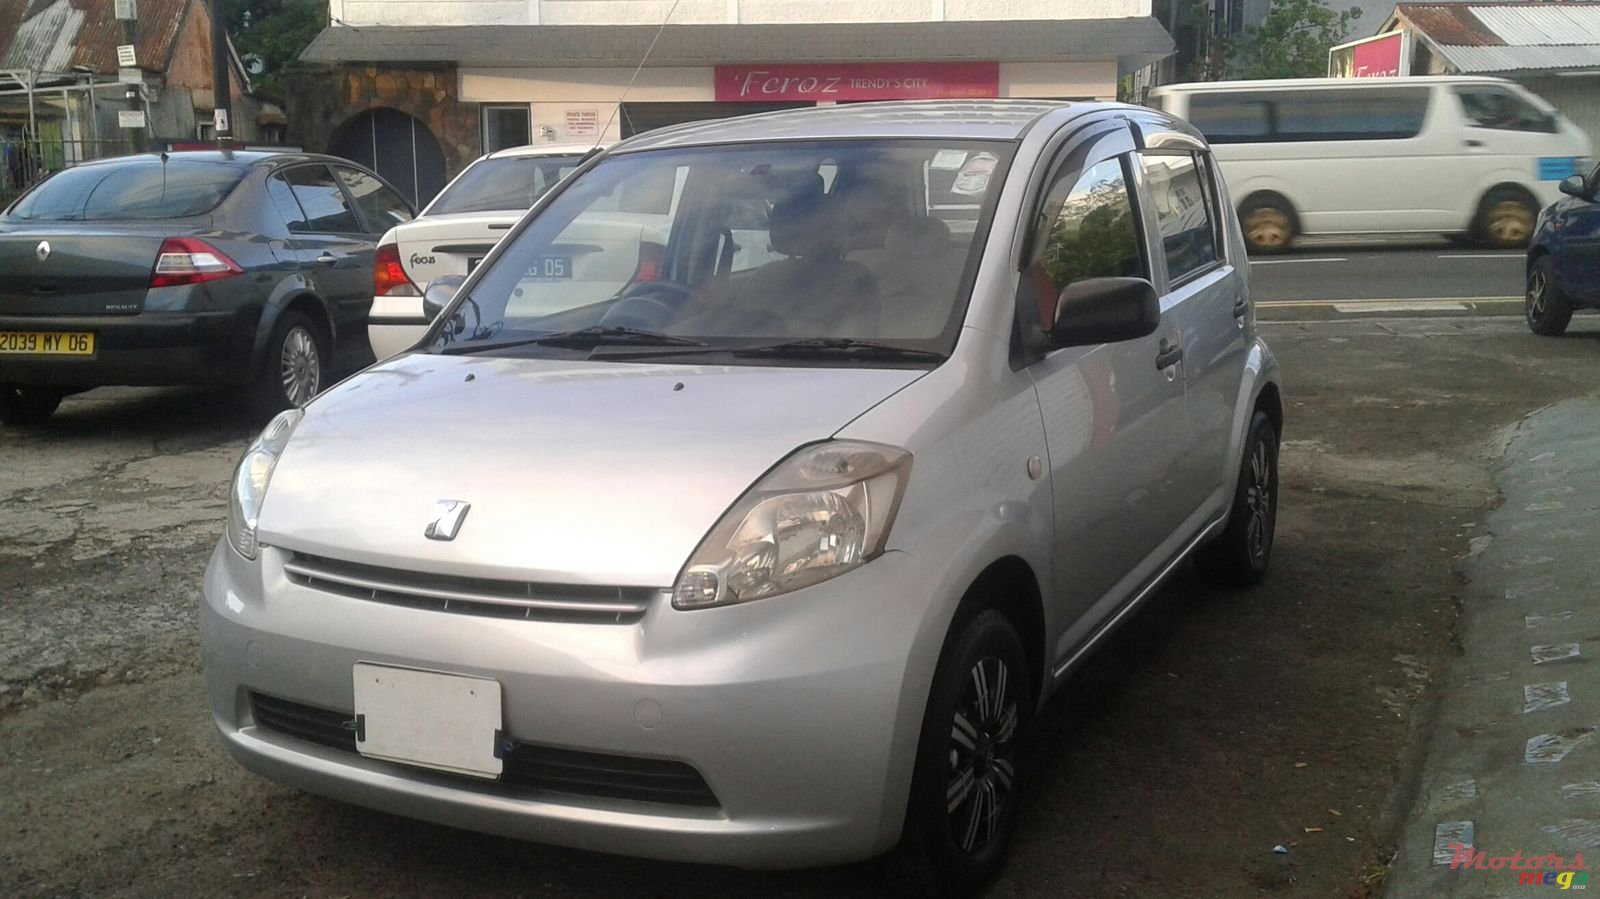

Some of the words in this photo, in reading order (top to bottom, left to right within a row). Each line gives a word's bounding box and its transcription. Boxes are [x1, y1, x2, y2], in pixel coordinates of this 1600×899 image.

[851, 78, 901, 89] TRENDY'S
[904, 78, 929, 88] CITY
[545, 259, 564, 276] 05
[0, 334, 37, 351] 2039
[43, 334, 62, 351] MY
[69, 335, 88, 351] 06
